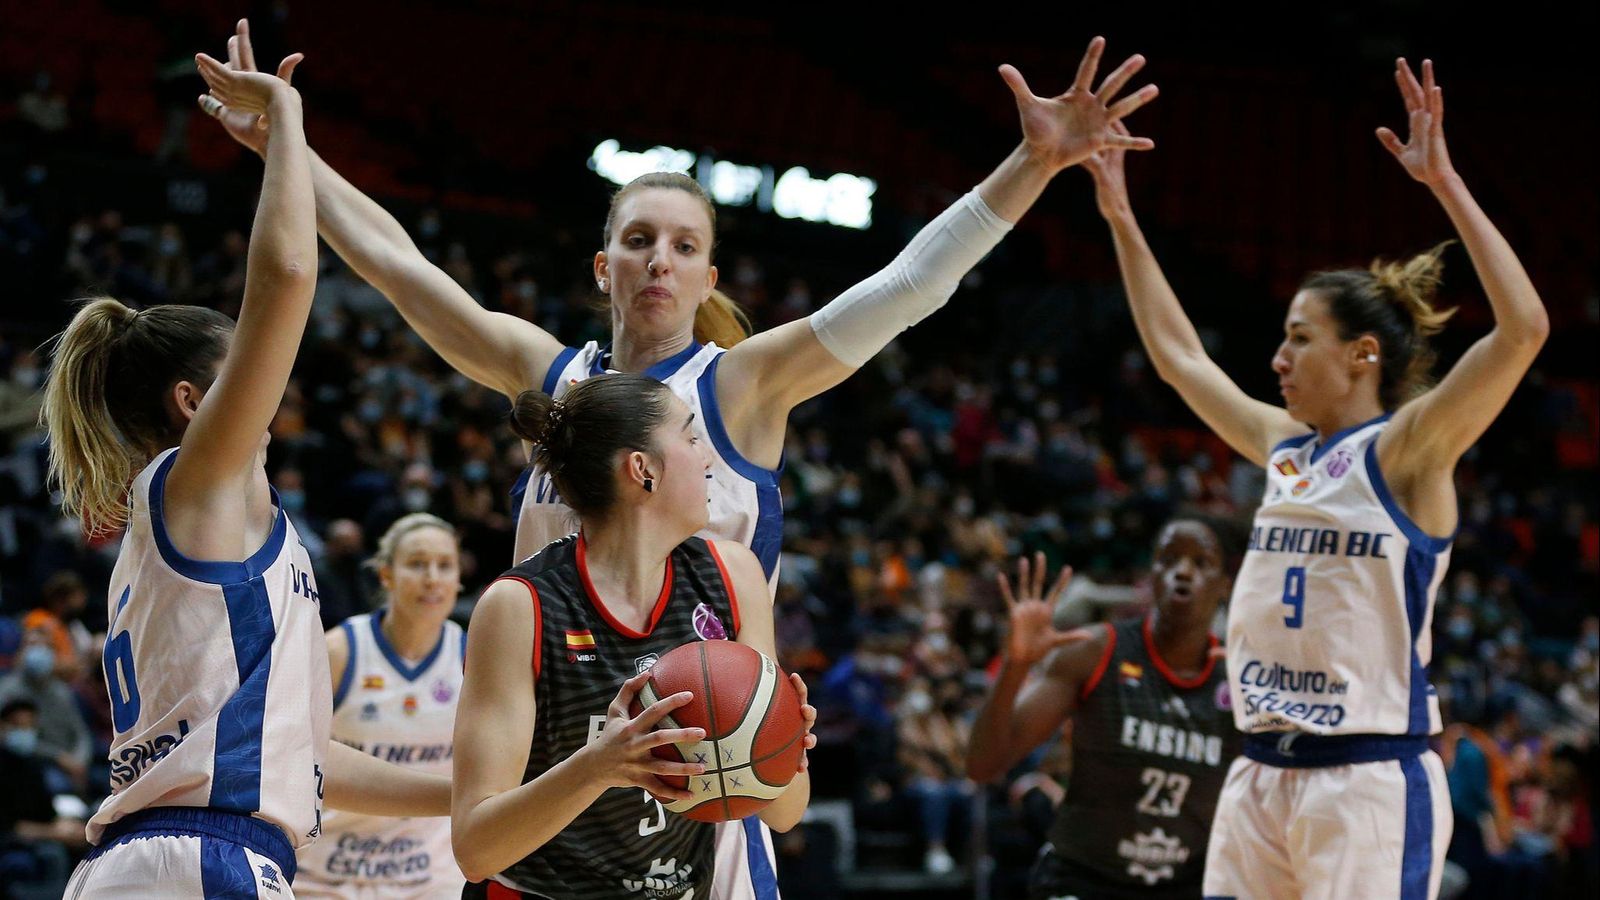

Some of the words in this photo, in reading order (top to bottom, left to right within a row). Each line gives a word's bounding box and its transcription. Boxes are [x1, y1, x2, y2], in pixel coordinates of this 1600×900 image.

[1345, 531, 1393, 559] BC
[1282, 566, 1307, 629] 9
[1240, 661, 1326, 693] Cultura
[1241, 688, 1345, 727] sfuerzo
[1136, 767, 1192, 818] 23
